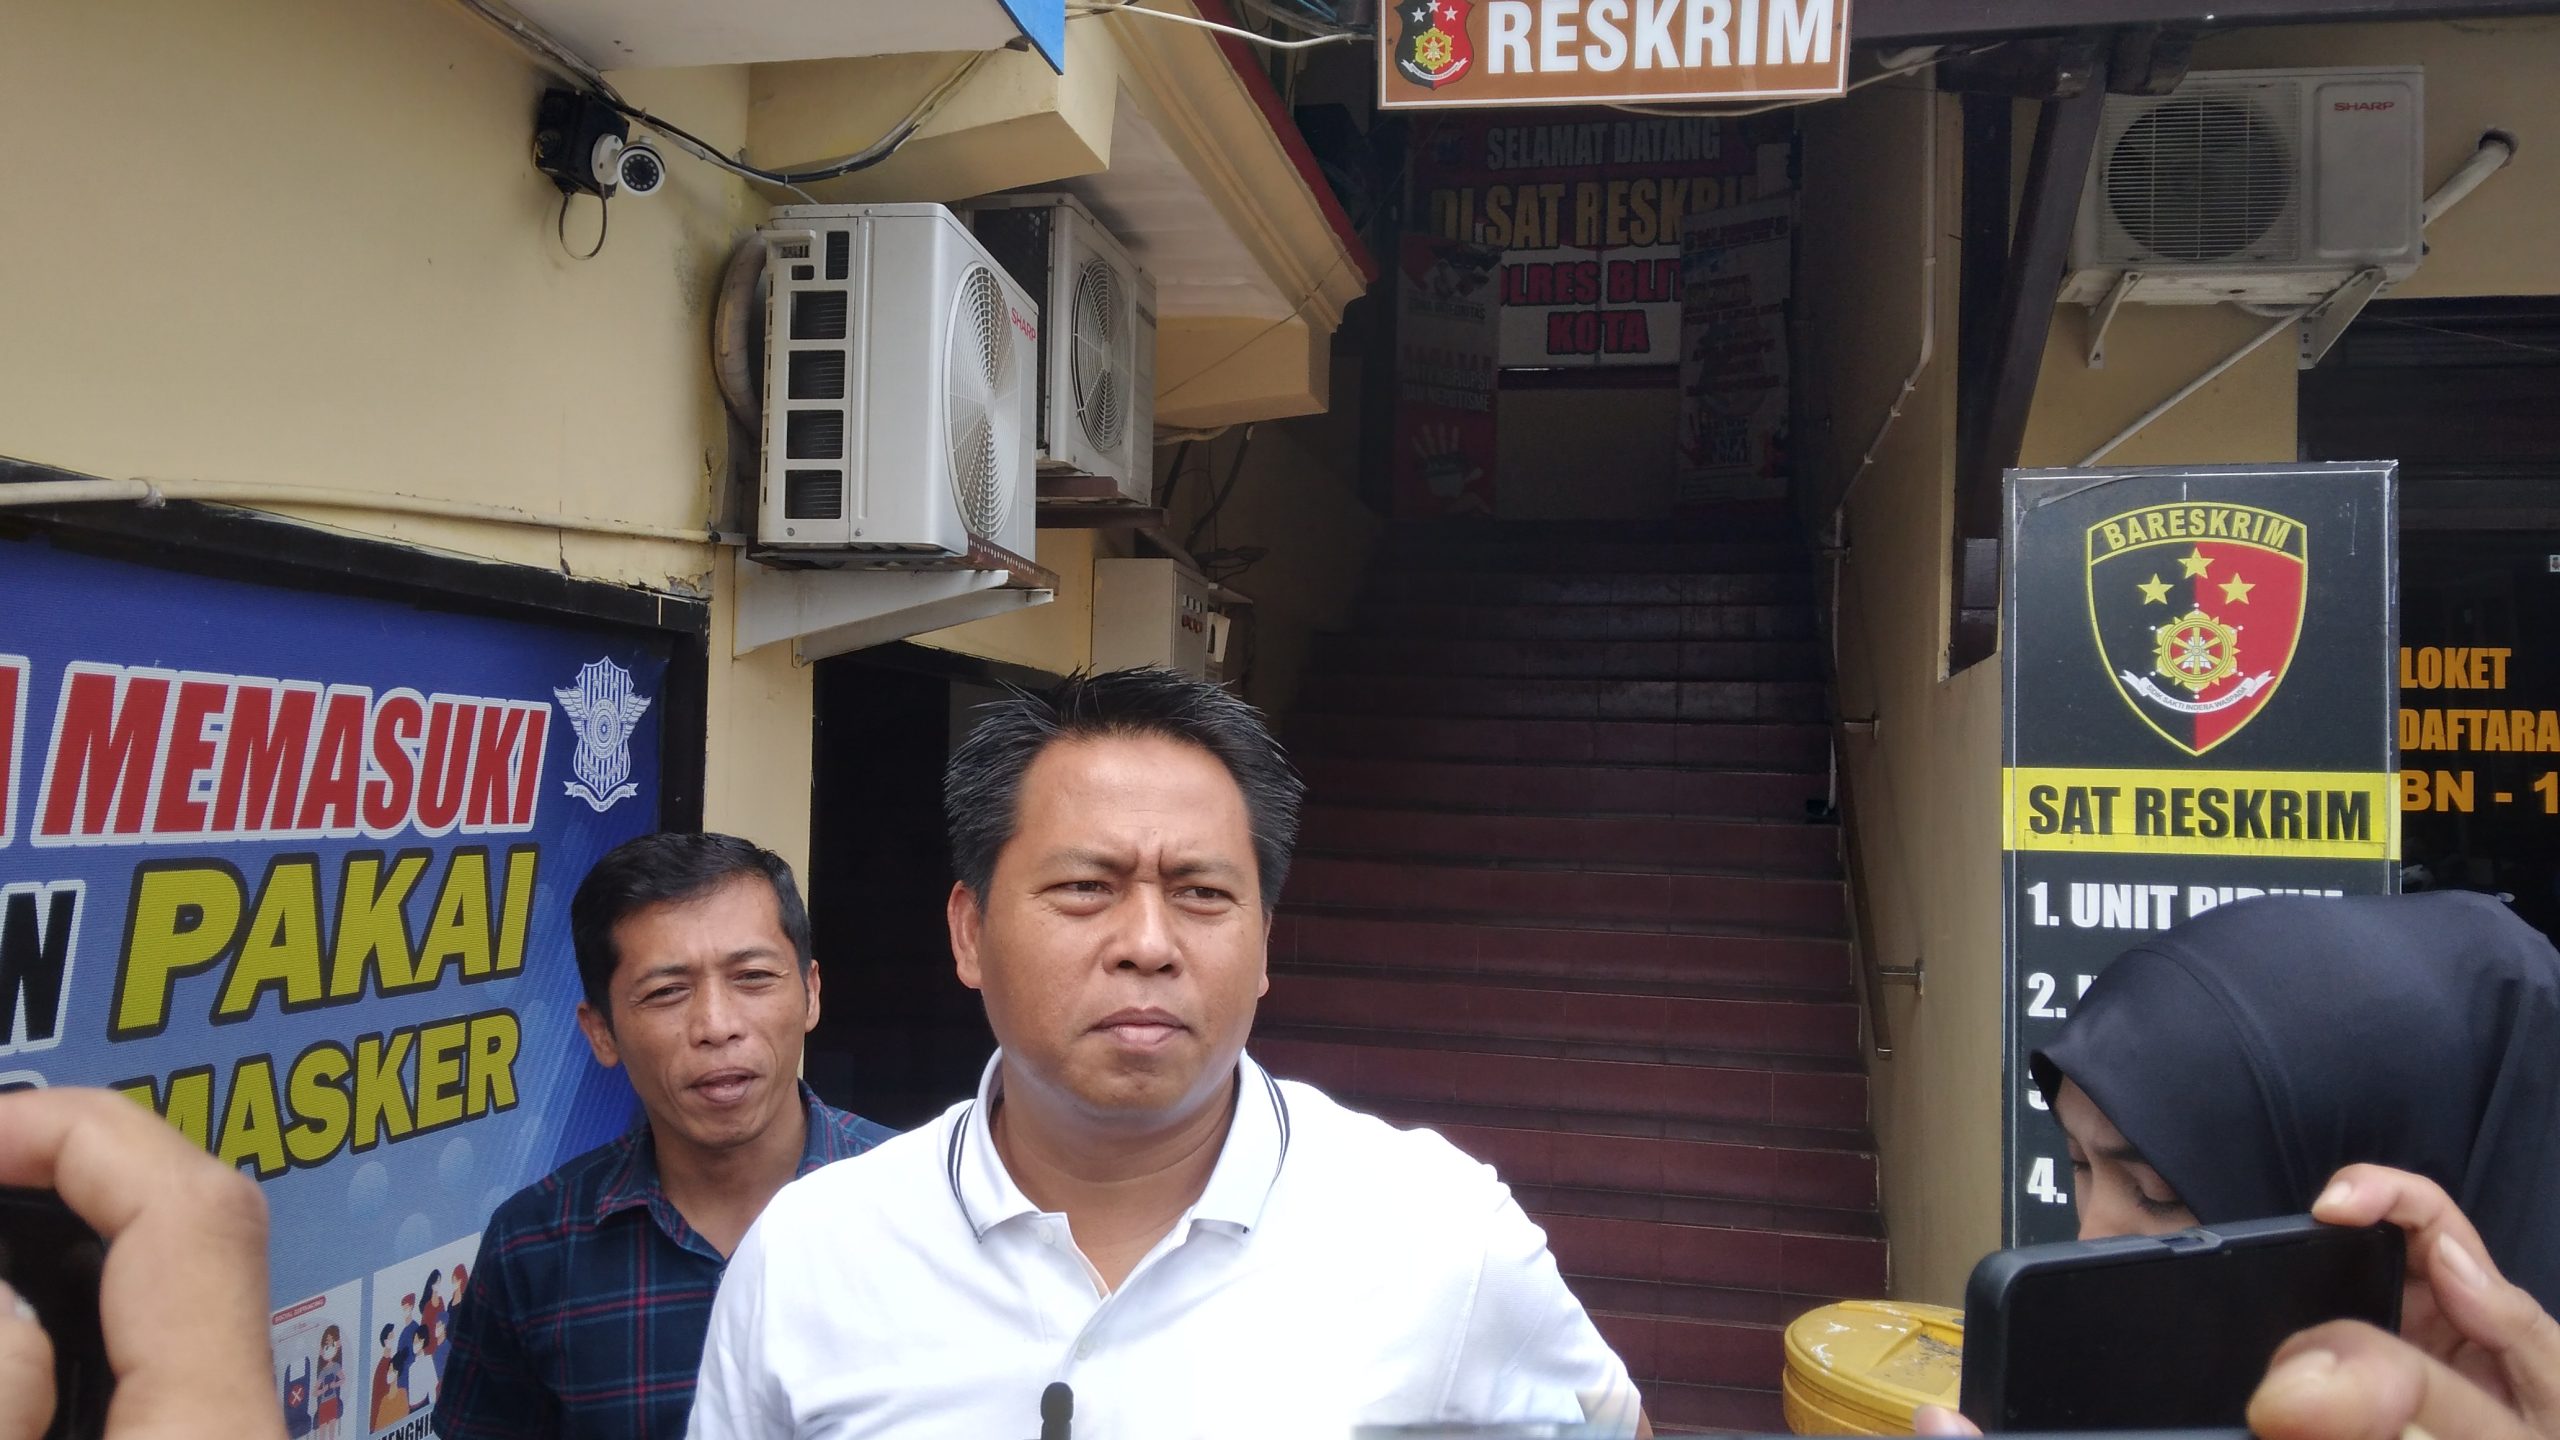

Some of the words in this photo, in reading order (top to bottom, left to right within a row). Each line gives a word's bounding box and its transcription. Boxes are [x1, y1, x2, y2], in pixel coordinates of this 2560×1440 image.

[1486, 0, 1832, 75] RESKRIM
[2333, 101, 2395, 112] SHARP
[1486, 122, 1608, 171] SELAMAT
[1613, 117, 1721, 165] DATANG
[1484, 183, 1567, 252] SAT
[1010, 306, 1037, 342] SHARP
[1547, 309, 1650, 356] KOTA
[2102, 508, 2293, 551] BARESKRIM
[2399, 646, 2513, 690] LOKET
[2163, 695, 2185, 710] SAKTI
[2185, 703, 2215, 711] INDERA
[2215, 686, 2247, 708] WASPADA
[33, 663, 551, 845] MEMASUKI
[2399, 708, 2560, 752] DAFTARA
[2028, 785, 2121, 837] SAT
[2135, 787, 2372, 842] RESKRIM
[2400, 769, 2475, 813] BN
[2027, 881, 2060, 927] 1.
[2070, 882, 2179, 931] UNIT
[109, 844, 538, 1043] PAKAI
[2027, 971, 2067, 1019] 2.
[2026, 1156, 2068, 1204] 4.
